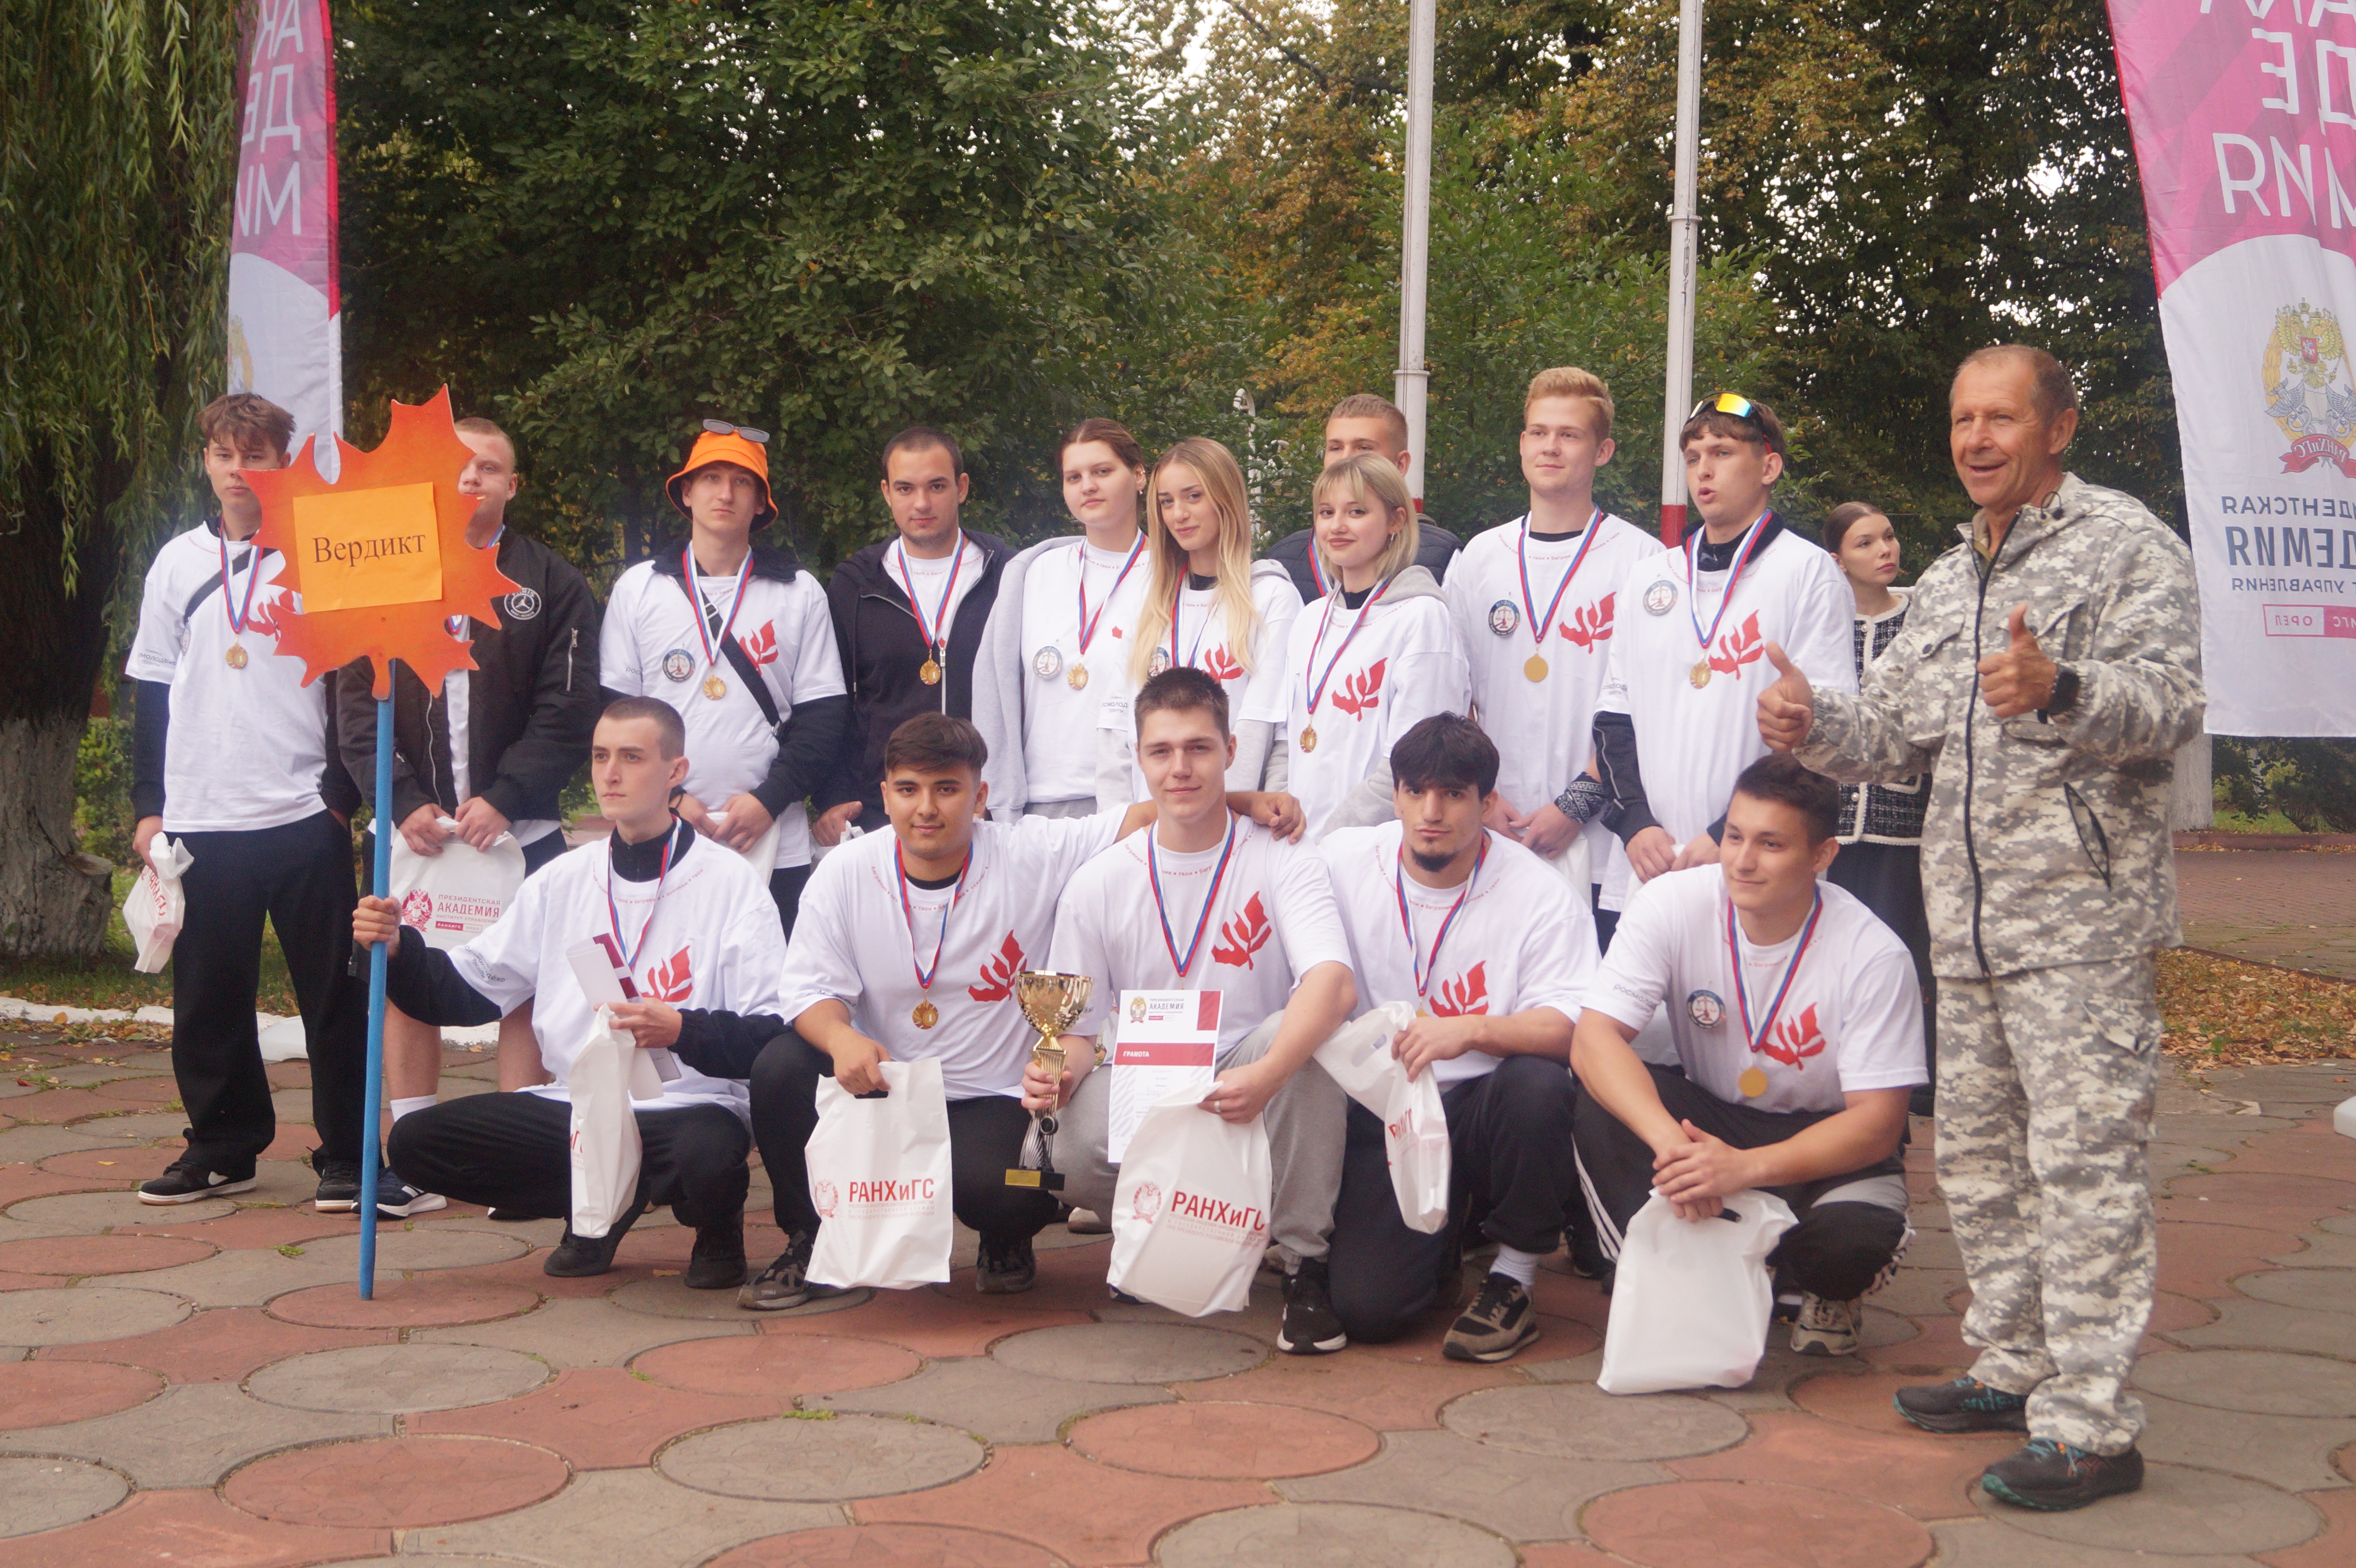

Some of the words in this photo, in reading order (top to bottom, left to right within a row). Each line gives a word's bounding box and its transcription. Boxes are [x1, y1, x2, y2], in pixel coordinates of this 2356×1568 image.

[313, 534, 426, 567] Вердикт
[437, 902, 500, 918] АКАДЕМИЯ
[439, 895, 500, 905] ПРЕЗИДЕНТСКАЯ
[849, 1178, 934, 1202] РАНХиГС
[1172, 1191, 1264, 1231] РАНХиГС
